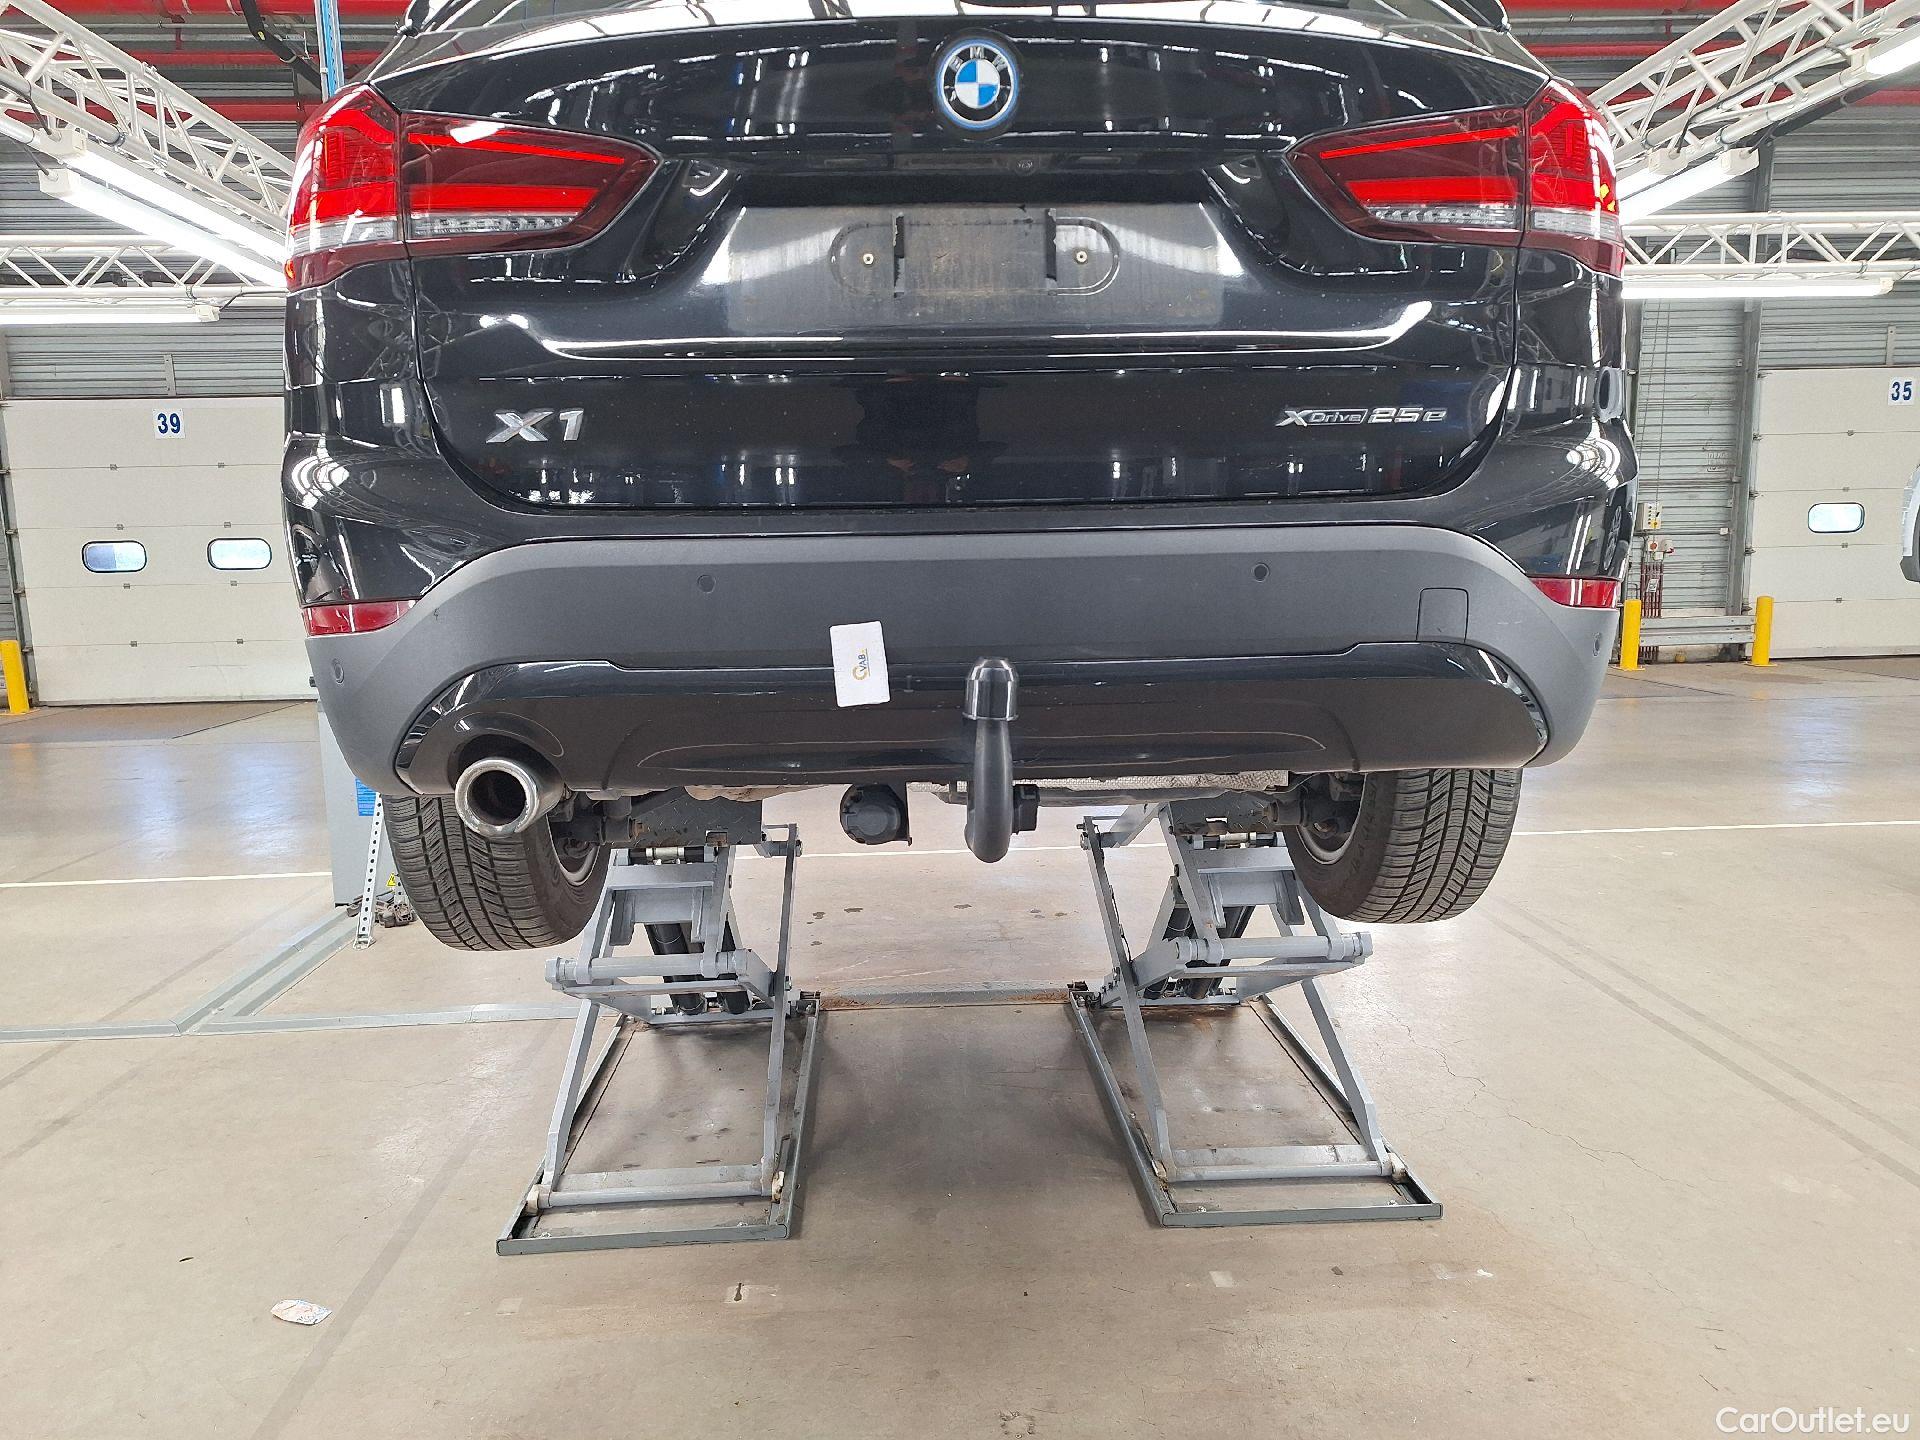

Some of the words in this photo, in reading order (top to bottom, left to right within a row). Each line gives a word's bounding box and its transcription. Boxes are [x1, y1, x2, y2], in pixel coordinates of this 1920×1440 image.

[1891, 381, 1912, 401] 35
[157, 413, 181, 434] 39
[486, 410, 584, 443] X1
